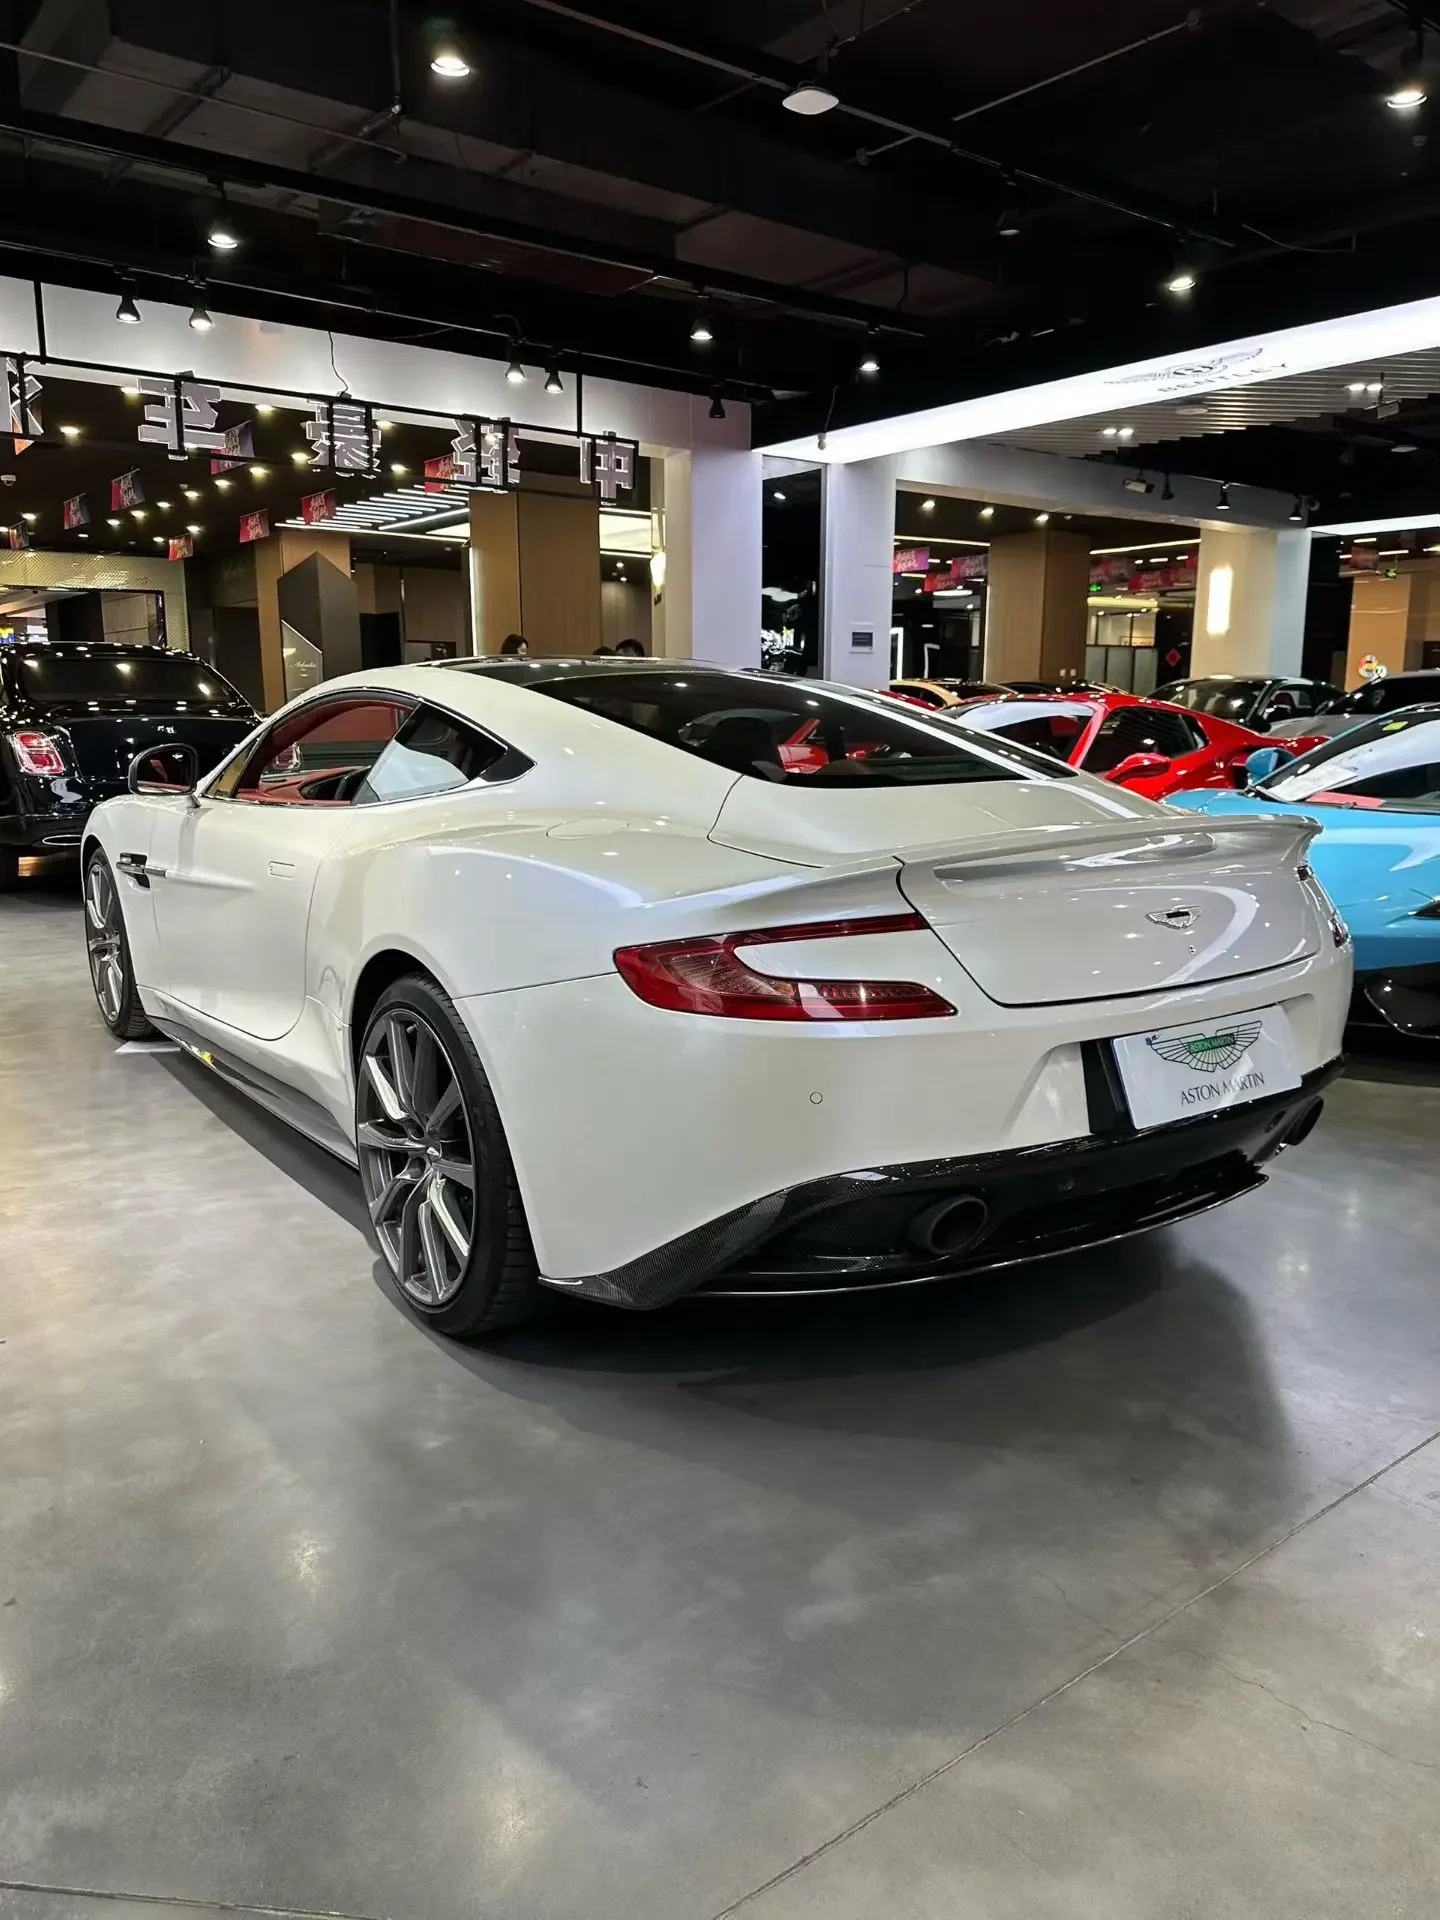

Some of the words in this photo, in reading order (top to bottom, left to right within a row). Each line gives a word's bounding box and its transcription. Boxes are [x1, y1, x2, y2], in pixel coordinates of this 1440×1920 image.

[1189, 1039, 1211, 1052] ASTON
[1210, 1034, 1233, 1048] MARTIN
[1181, 1083, 1220, 1105] ASTON
[1222, 1072, 1264, 1095] MARTIN
